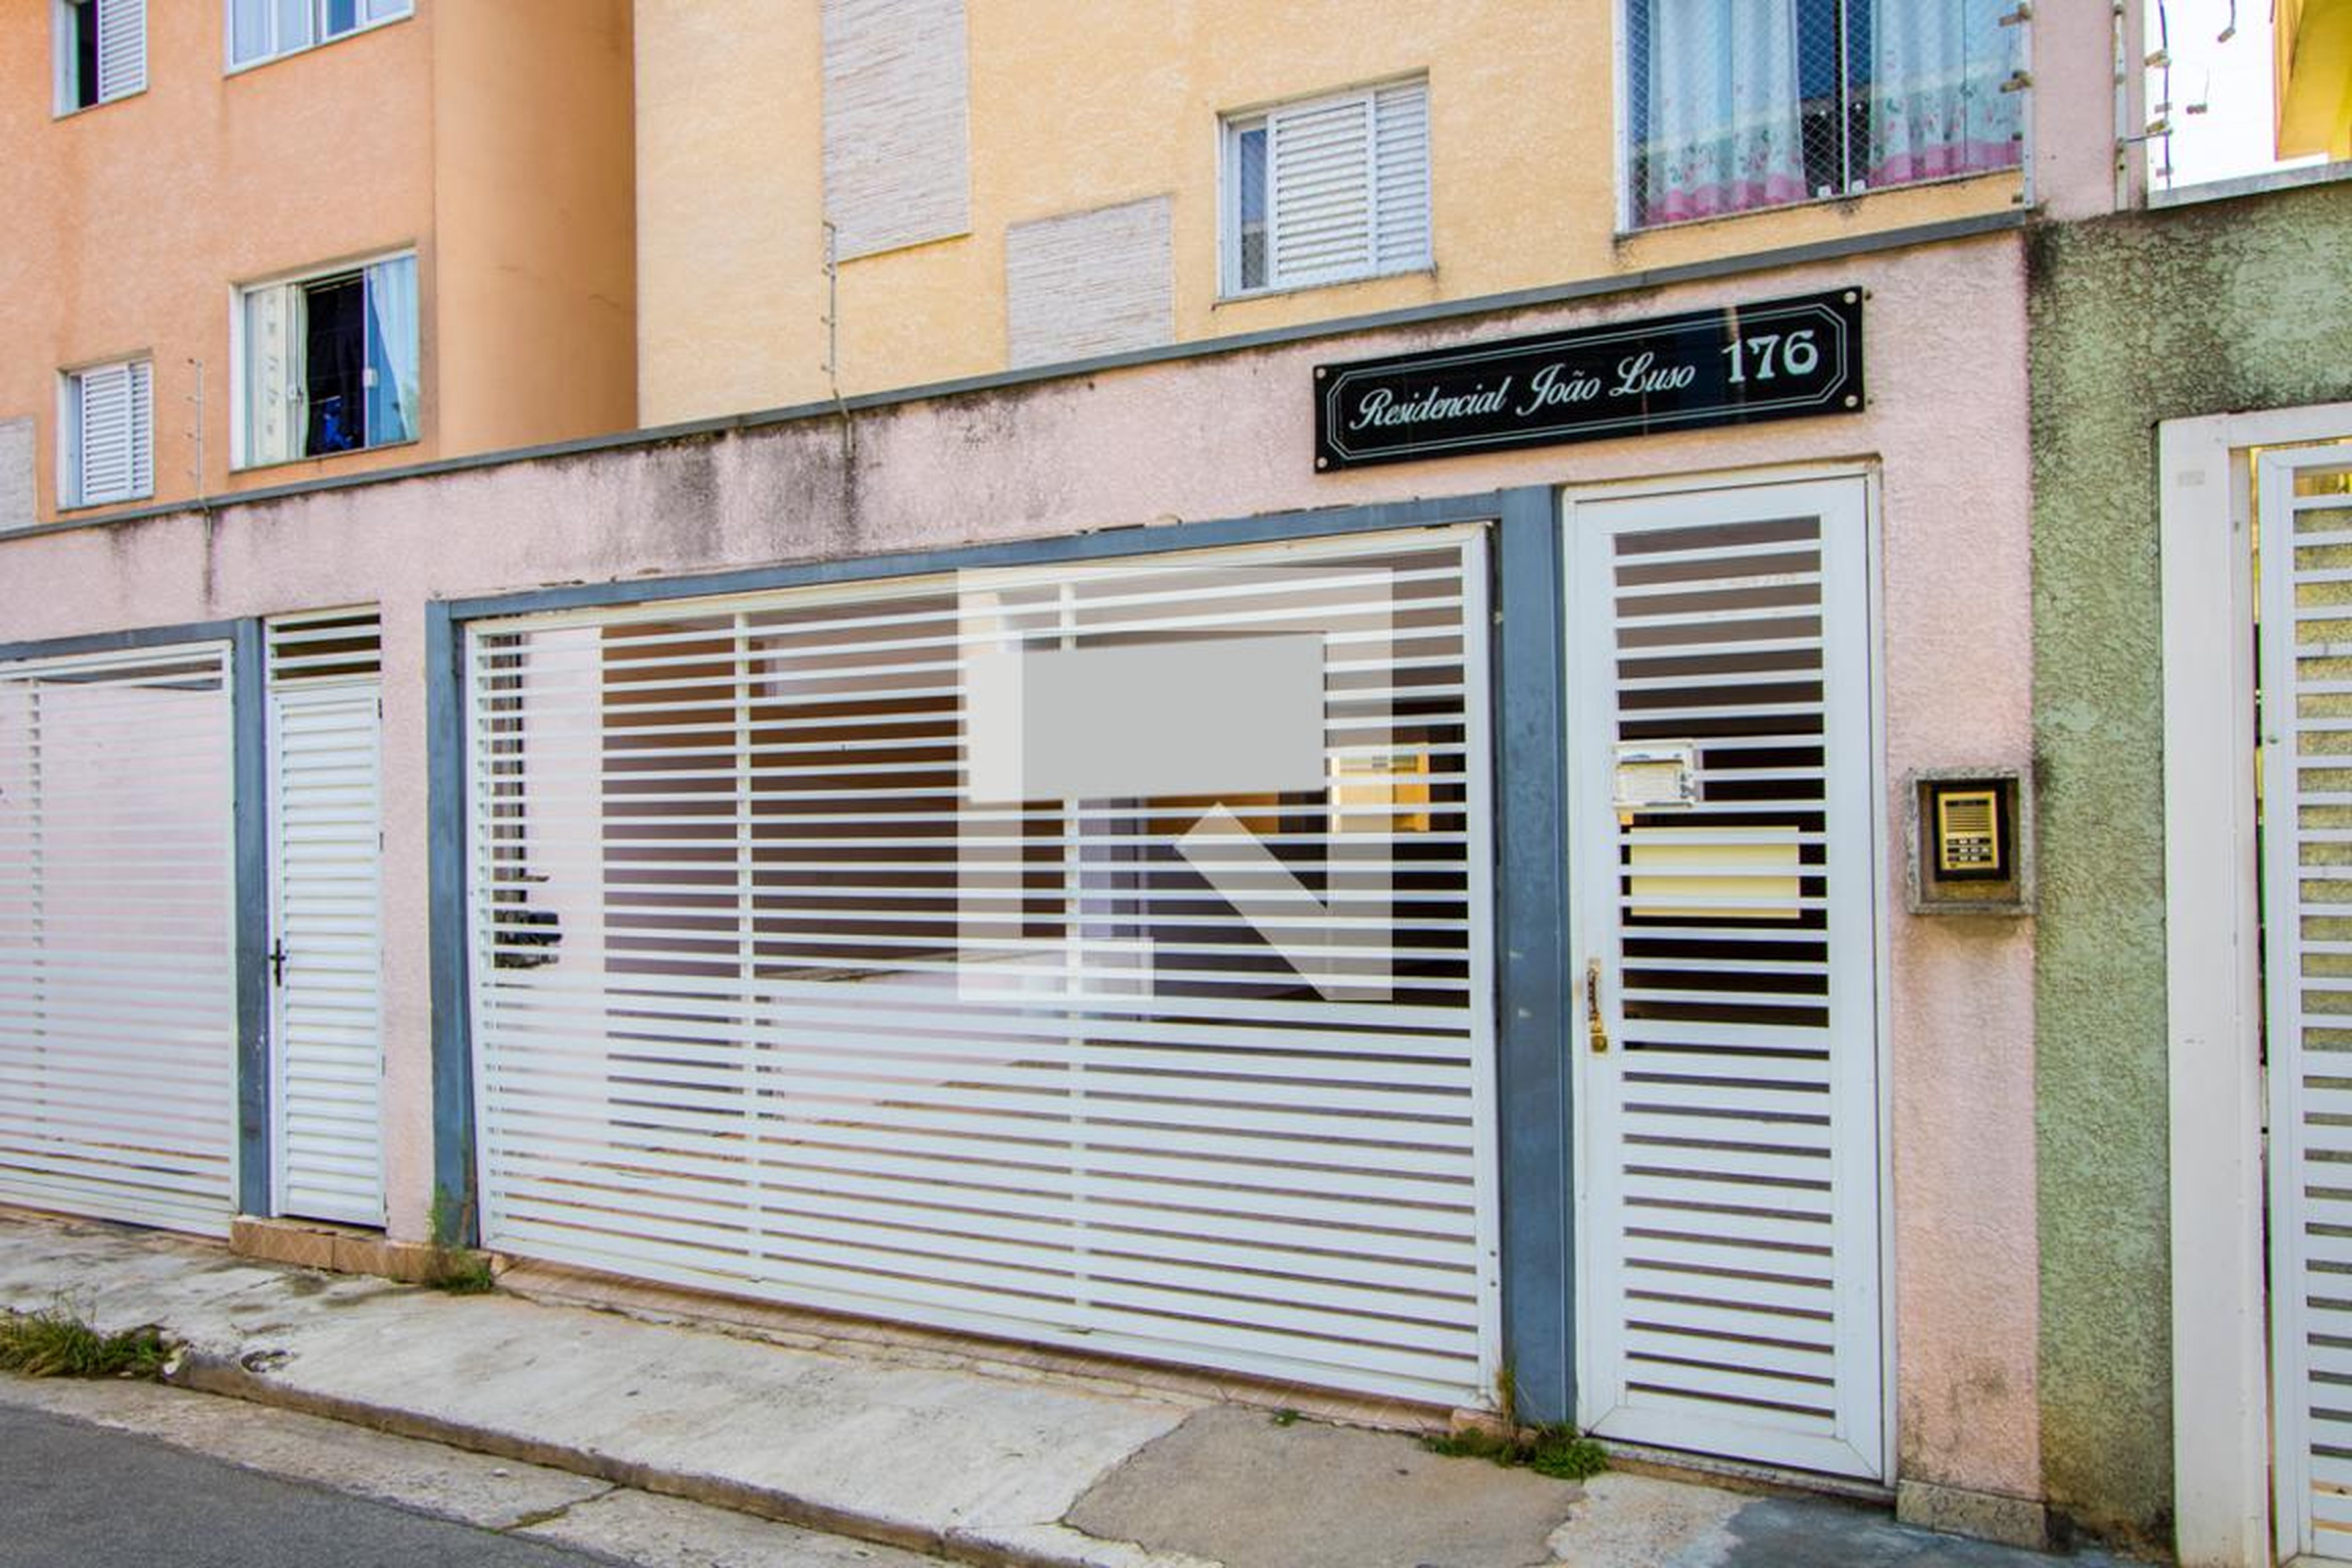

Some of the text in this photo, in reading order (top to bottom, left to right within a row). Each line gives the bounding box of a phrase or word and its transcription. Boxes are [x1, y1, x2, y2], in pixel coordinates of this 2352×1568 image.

[1349, 329, 1819, 430] Residencial João Luso 176
